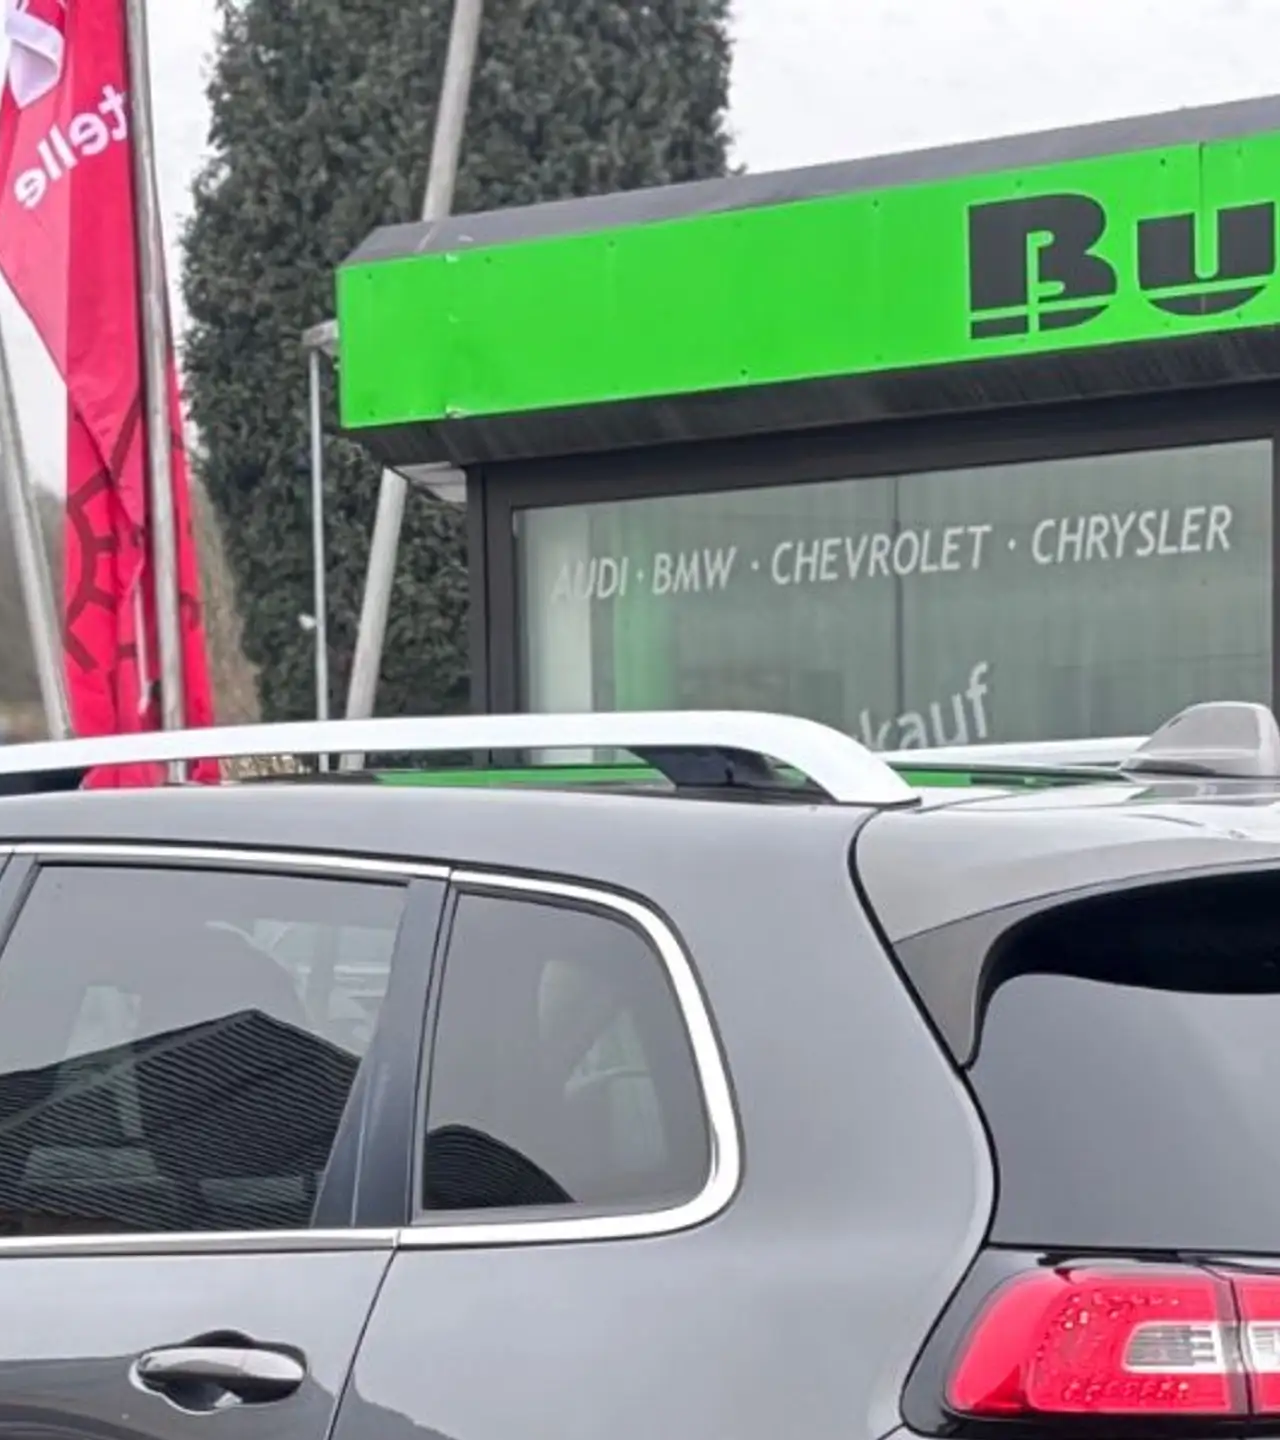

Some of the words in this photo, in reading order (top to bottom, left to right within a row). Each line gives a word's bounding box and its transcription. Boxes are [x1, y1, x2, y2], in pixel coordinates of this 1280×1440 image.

[550, 556, 629, 605] AUDI
[652, 546, 738, 596] BMW
[771, 525, 993, 585] CHEVROLET
[1031, 504, 1233, 565] CHRYSLER
